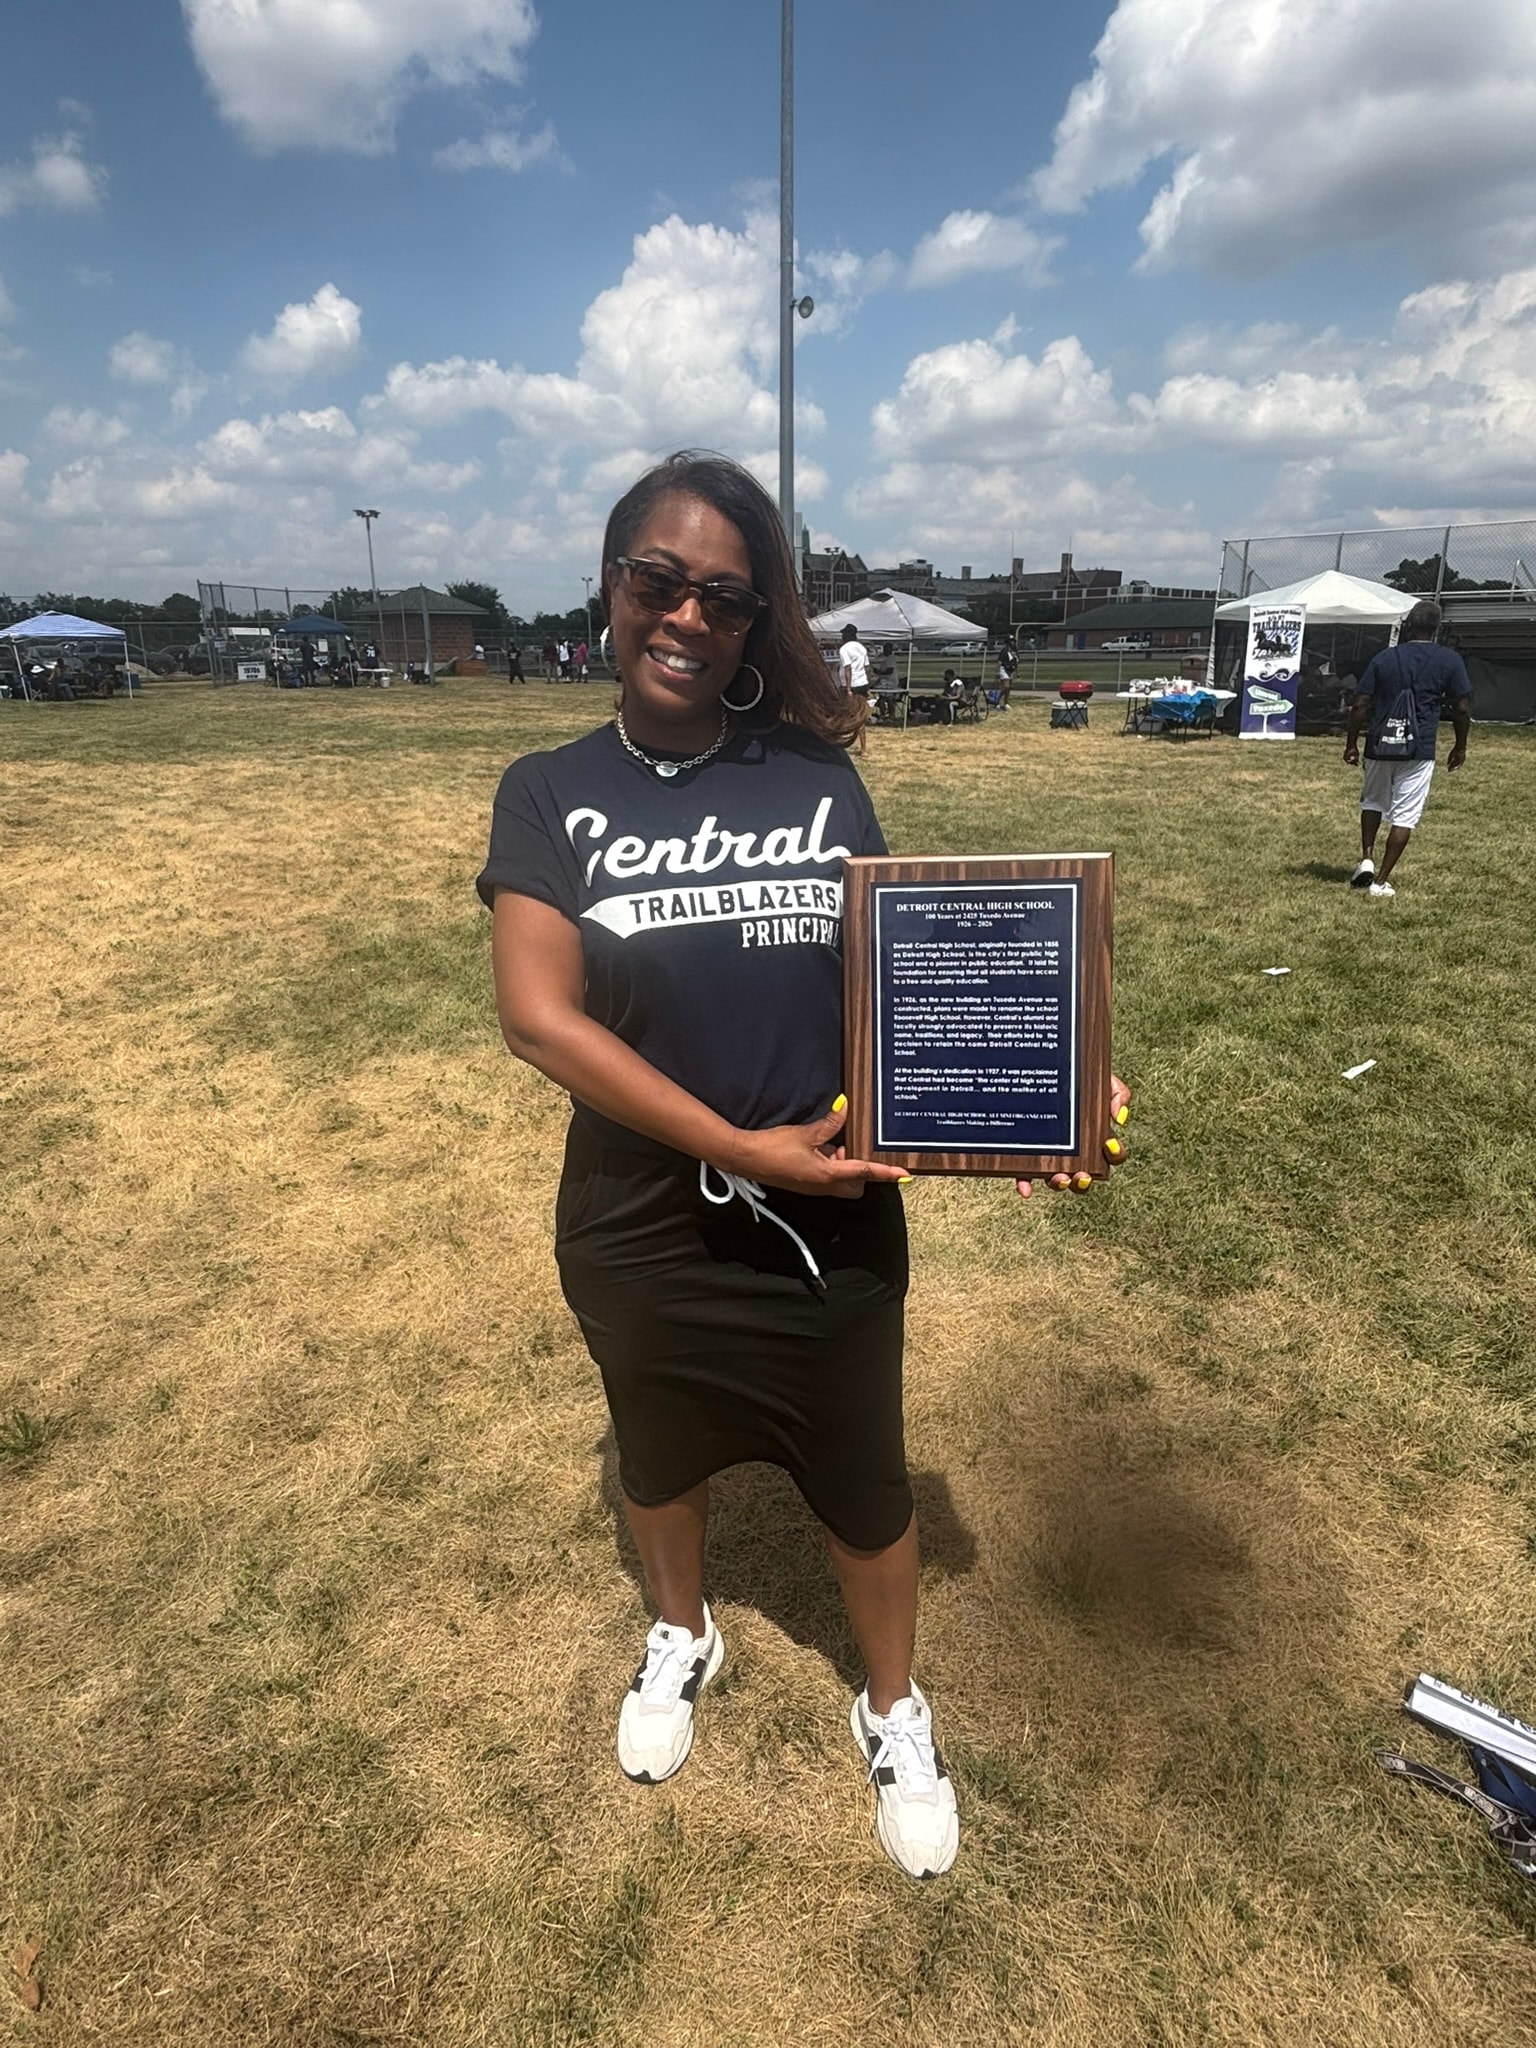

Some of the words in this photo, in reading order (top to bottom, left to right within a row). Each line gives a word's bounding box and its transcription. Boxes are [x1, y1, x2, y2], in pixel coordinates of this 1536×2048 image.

[1253, 621, 1301, 633] TRAILBLAZERS
[565, 797, 852, 888] Central
[630, 884, 837, 924] TRAILBLAZERS
[897, 903, 938, 911] DETROIT
[941, 903, 985, 911] CENTRAL
[987, 902, 1011, 910] HIGH
[1014, 902, 1055, 910] SCHOOL
